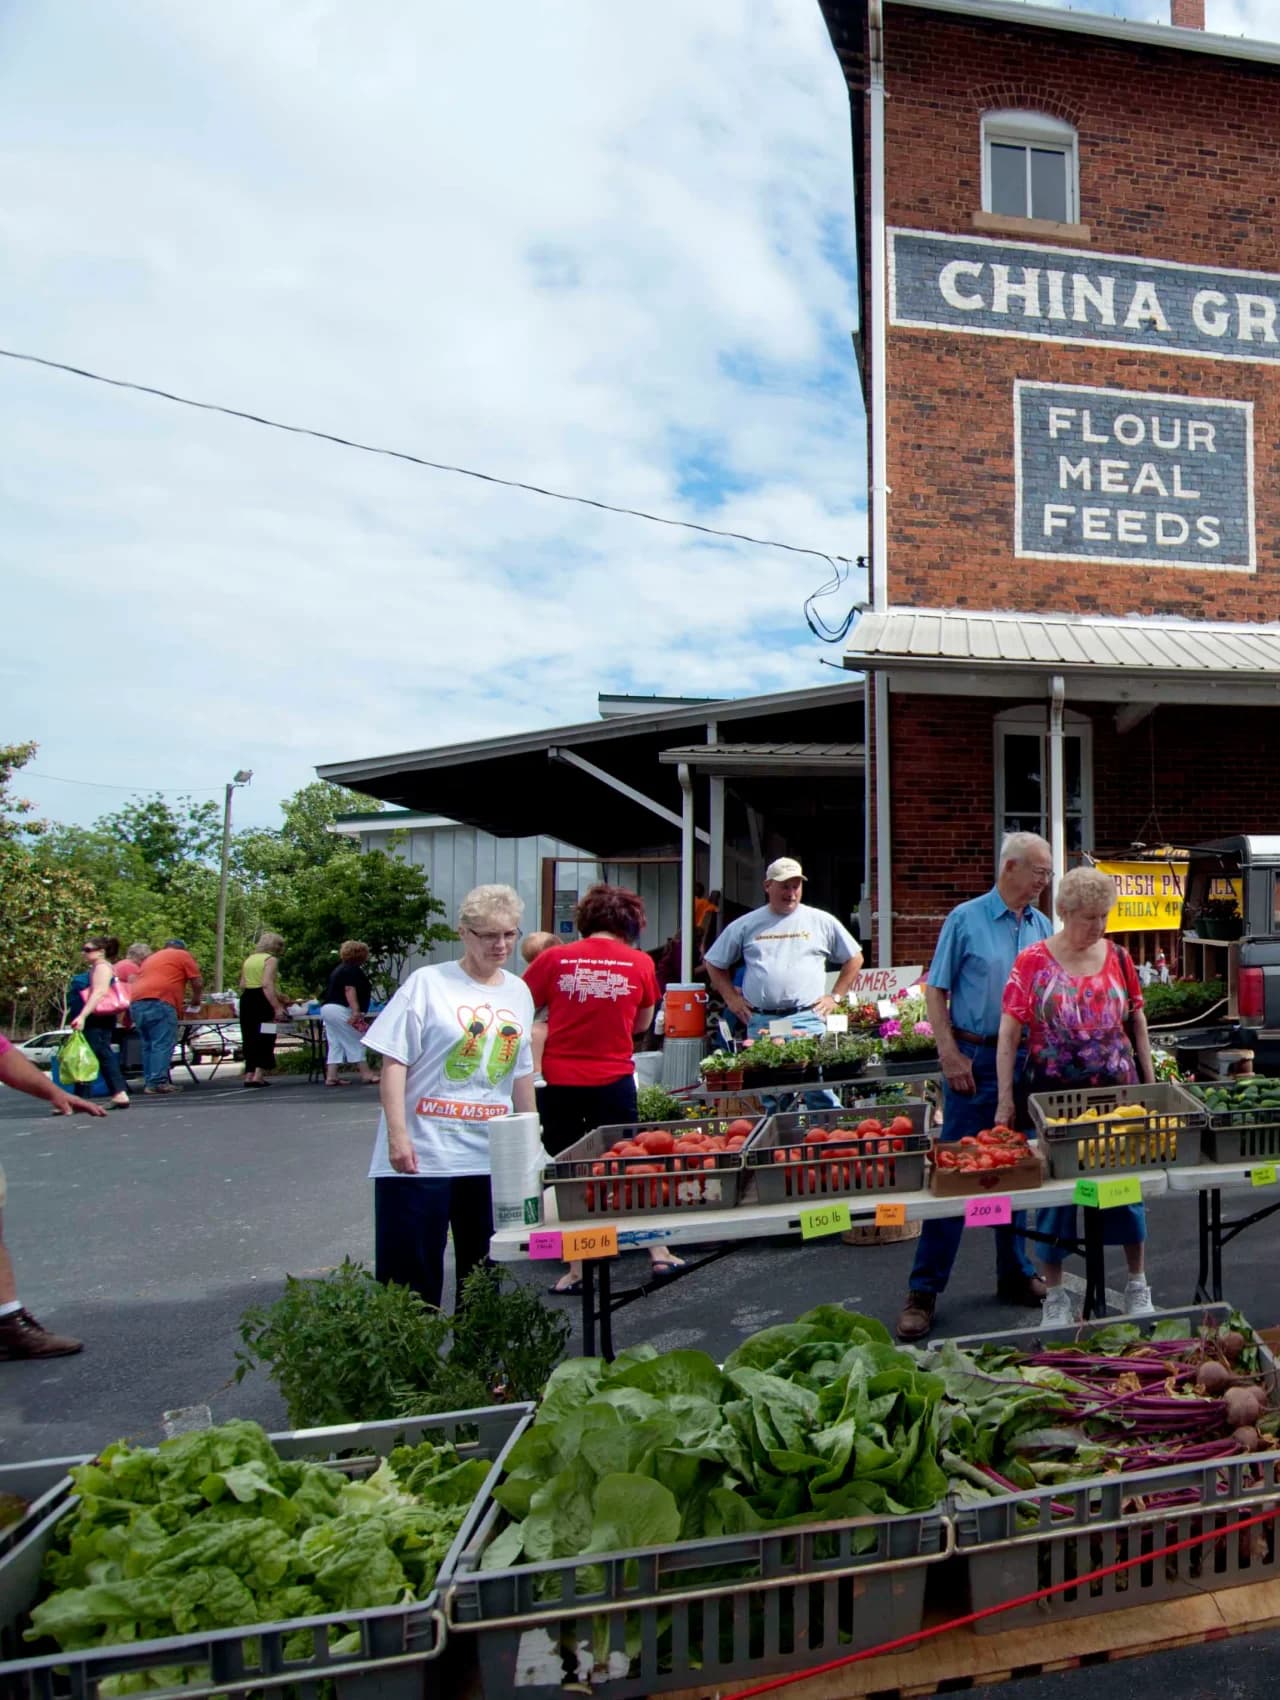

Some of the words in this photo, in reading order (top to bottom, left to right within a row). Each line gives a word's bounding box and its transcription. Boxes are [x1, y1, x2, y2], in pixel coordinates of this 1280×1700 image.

[938, 259, 1167, 333] CHINA
[1048, 406, 1216, 453] FLOUR
[1059, 455, 1201, 499] MEAL
[1042, 503, 1221, 549] FEEDS
[1109, 874, 1154, 896] RESH
[1117, 901, 1159, 917] FRIDAY
[1165, 901, 1184, 914] 4P
[422, 1101, 458, 1115] Walk
[461, 1105, 484, 1117] MS
[832, 1211, 841, 1223] lb
[573, 1238, 596, 1252] 1.50
[600, 1234, 611, 1247] lb
